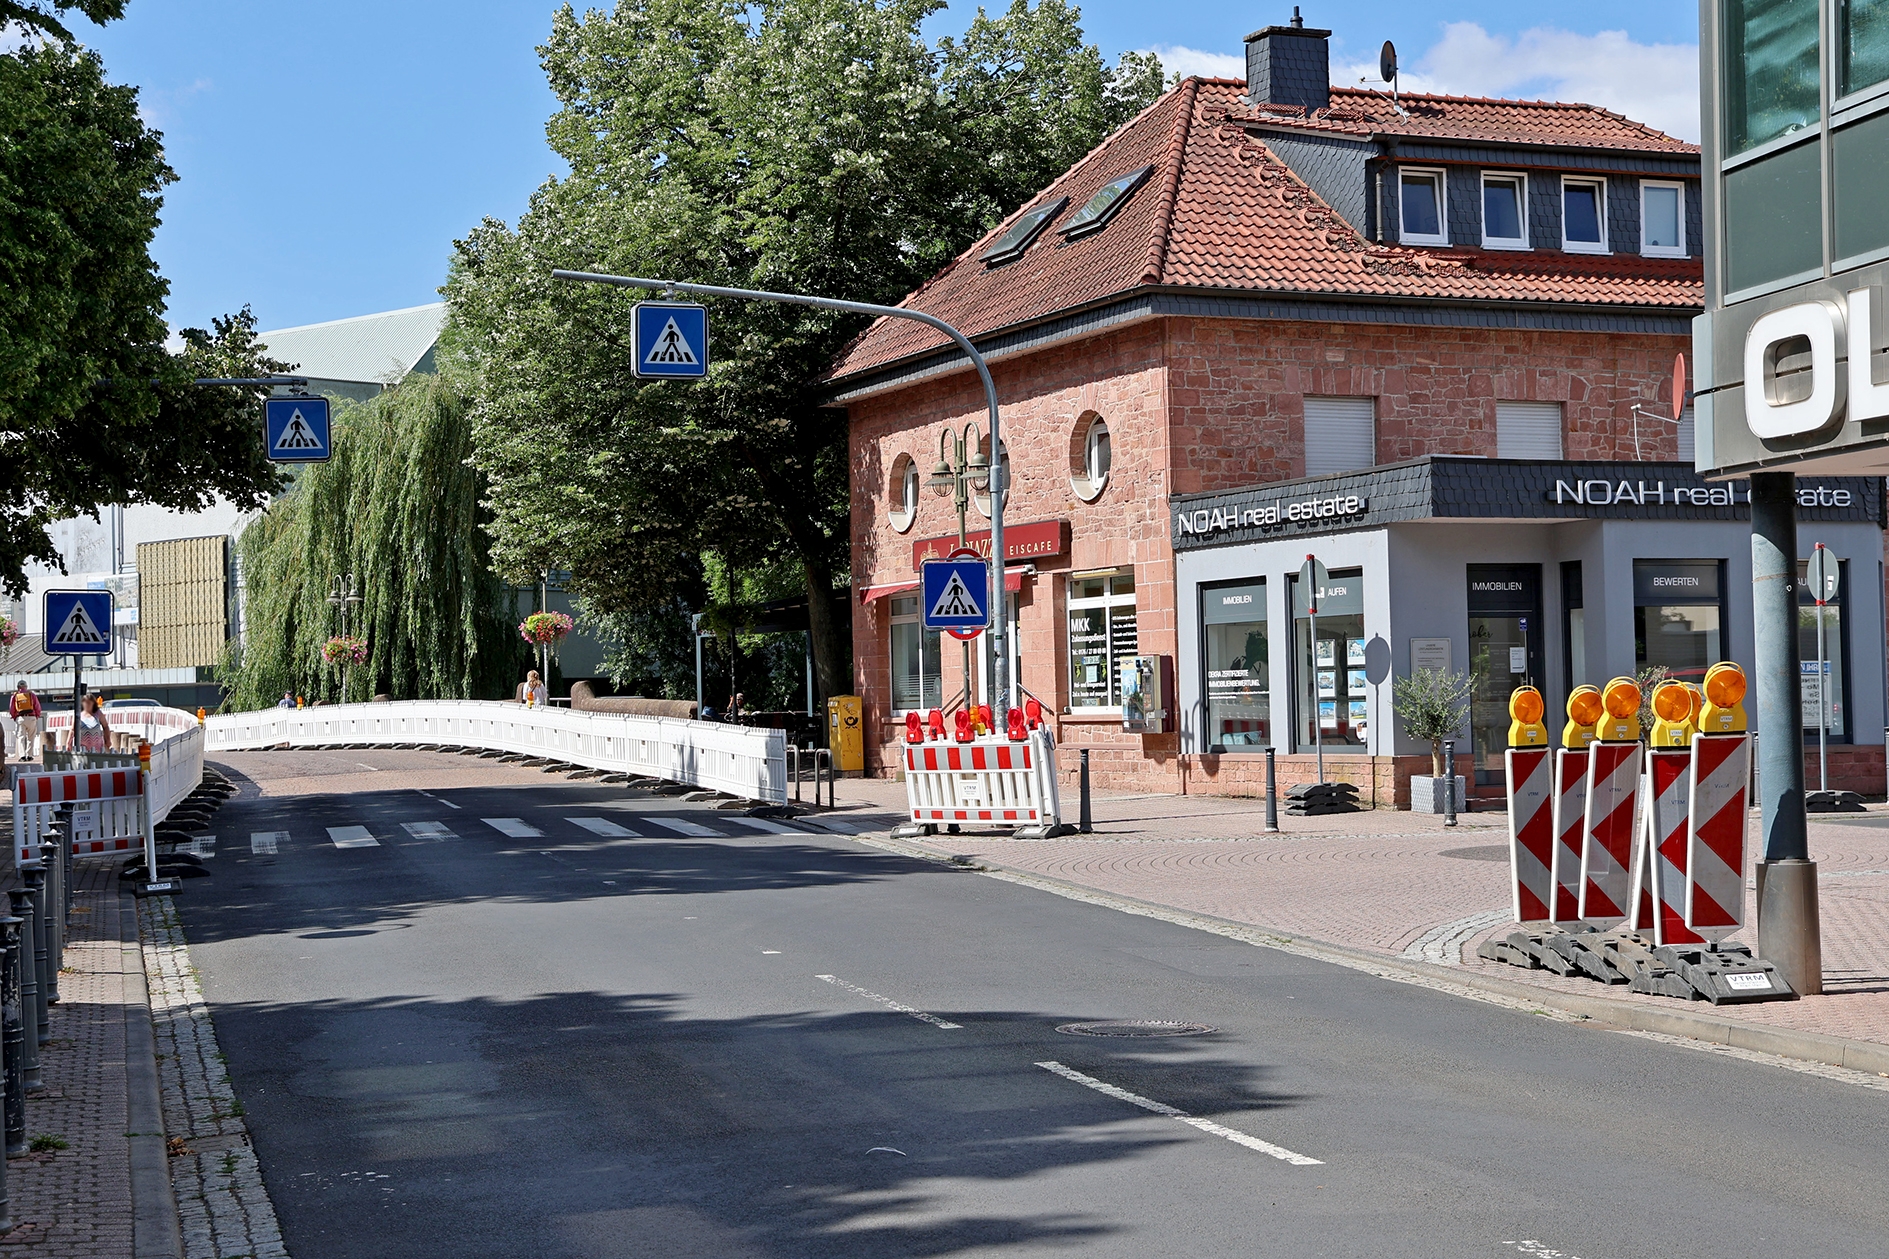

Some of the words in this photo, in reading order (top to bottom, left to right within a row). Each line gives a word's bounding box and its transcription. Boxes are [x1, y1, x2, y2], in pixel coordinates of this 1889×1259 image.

[1556, 479, 1665, 505] NOAH
[1674, 481, 1734, 506] real
[1178, 505, 1239, 535] NOAH
[1243, 499, 1281, 526] real
[1288, 494, 1359, 521] estate
[1009, 540, 1052, 556] EISCAFE
[1472, 581, 1523, 591] IMMOBILIEN
[1653, 577, 1699, 586] BEWERTEN
[1222, 594, 1252, 605] IMMOBILIEN
[1071, 617, 1090, 632] MKK
[1730, 974, 1765, 982] VTRM
